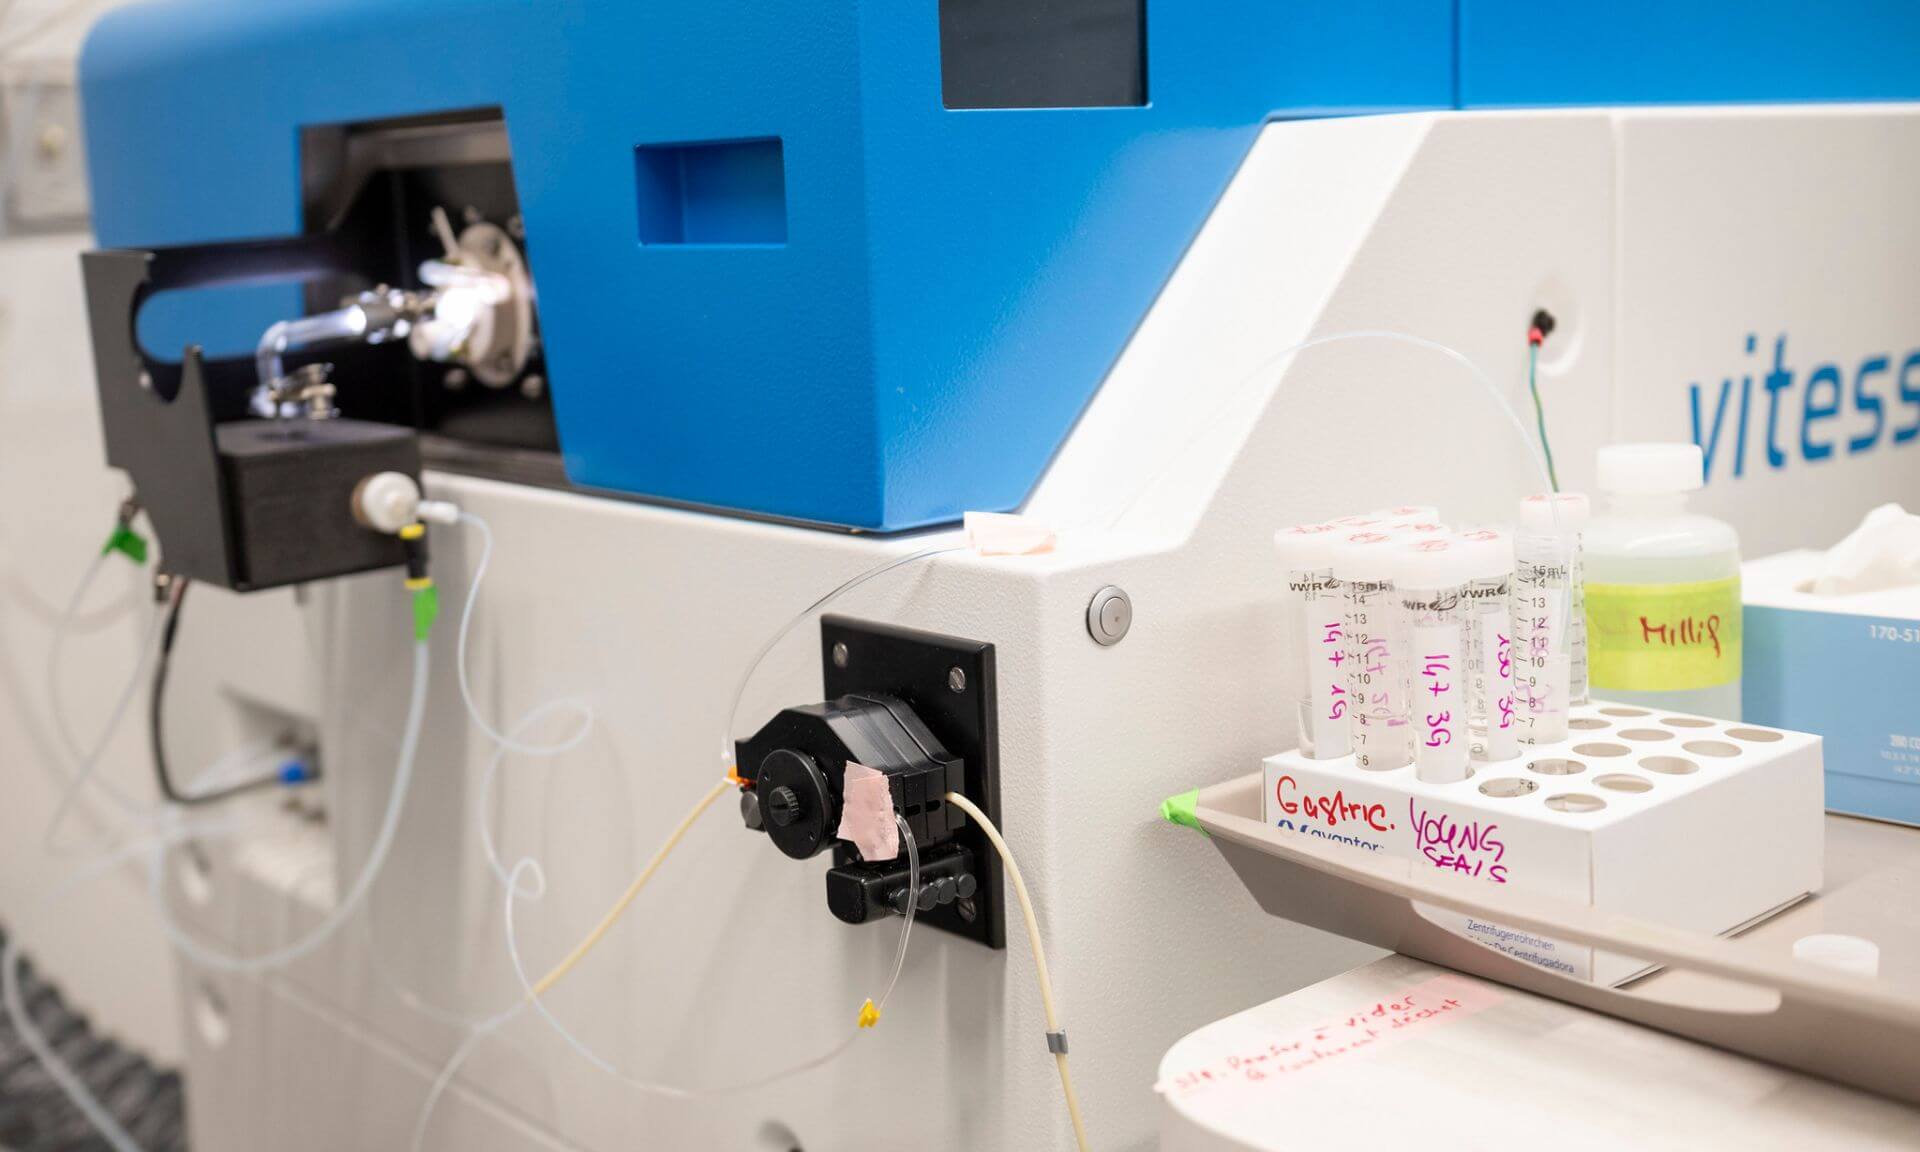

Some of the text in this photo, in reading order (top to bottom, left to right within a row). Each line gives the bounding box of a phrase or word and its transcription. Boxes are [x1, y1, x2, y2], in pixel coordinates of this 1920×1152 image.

[1289, 582, 1323, 592] VWR
[1532, 578, 1546, 589] 14
[1460, 587, 1497, 599] VWR
[1352, 594, 1366, 605] 14
[1531, 597, 1546, 609] 13
[1353, 613, 1367, 625] 13
[1531, 617, 1547, 629] 12
[1355, 633, 1369, 645] 12
[1531, 637, 1546, 649] 11
[1356, 653, 1370, 665] 11
[1531, 657, 1545, 668] 10
[1358, 673, 1371, 685] 10
[1529, 676, 1537, 688] 9
[1358, 693, 1365, 704] 9
[1529, 697, 1537, 709] 8
[1360, 713, 1367, 725] 8
[1529, 718, 1536, 728] 7
[1360, 734, 1367, 745] 7
[1362, 754, 1370, 766] 6
[1409, 797, 1505, 863] YOUNG
[1344, 996, 1417, 1028] vider
